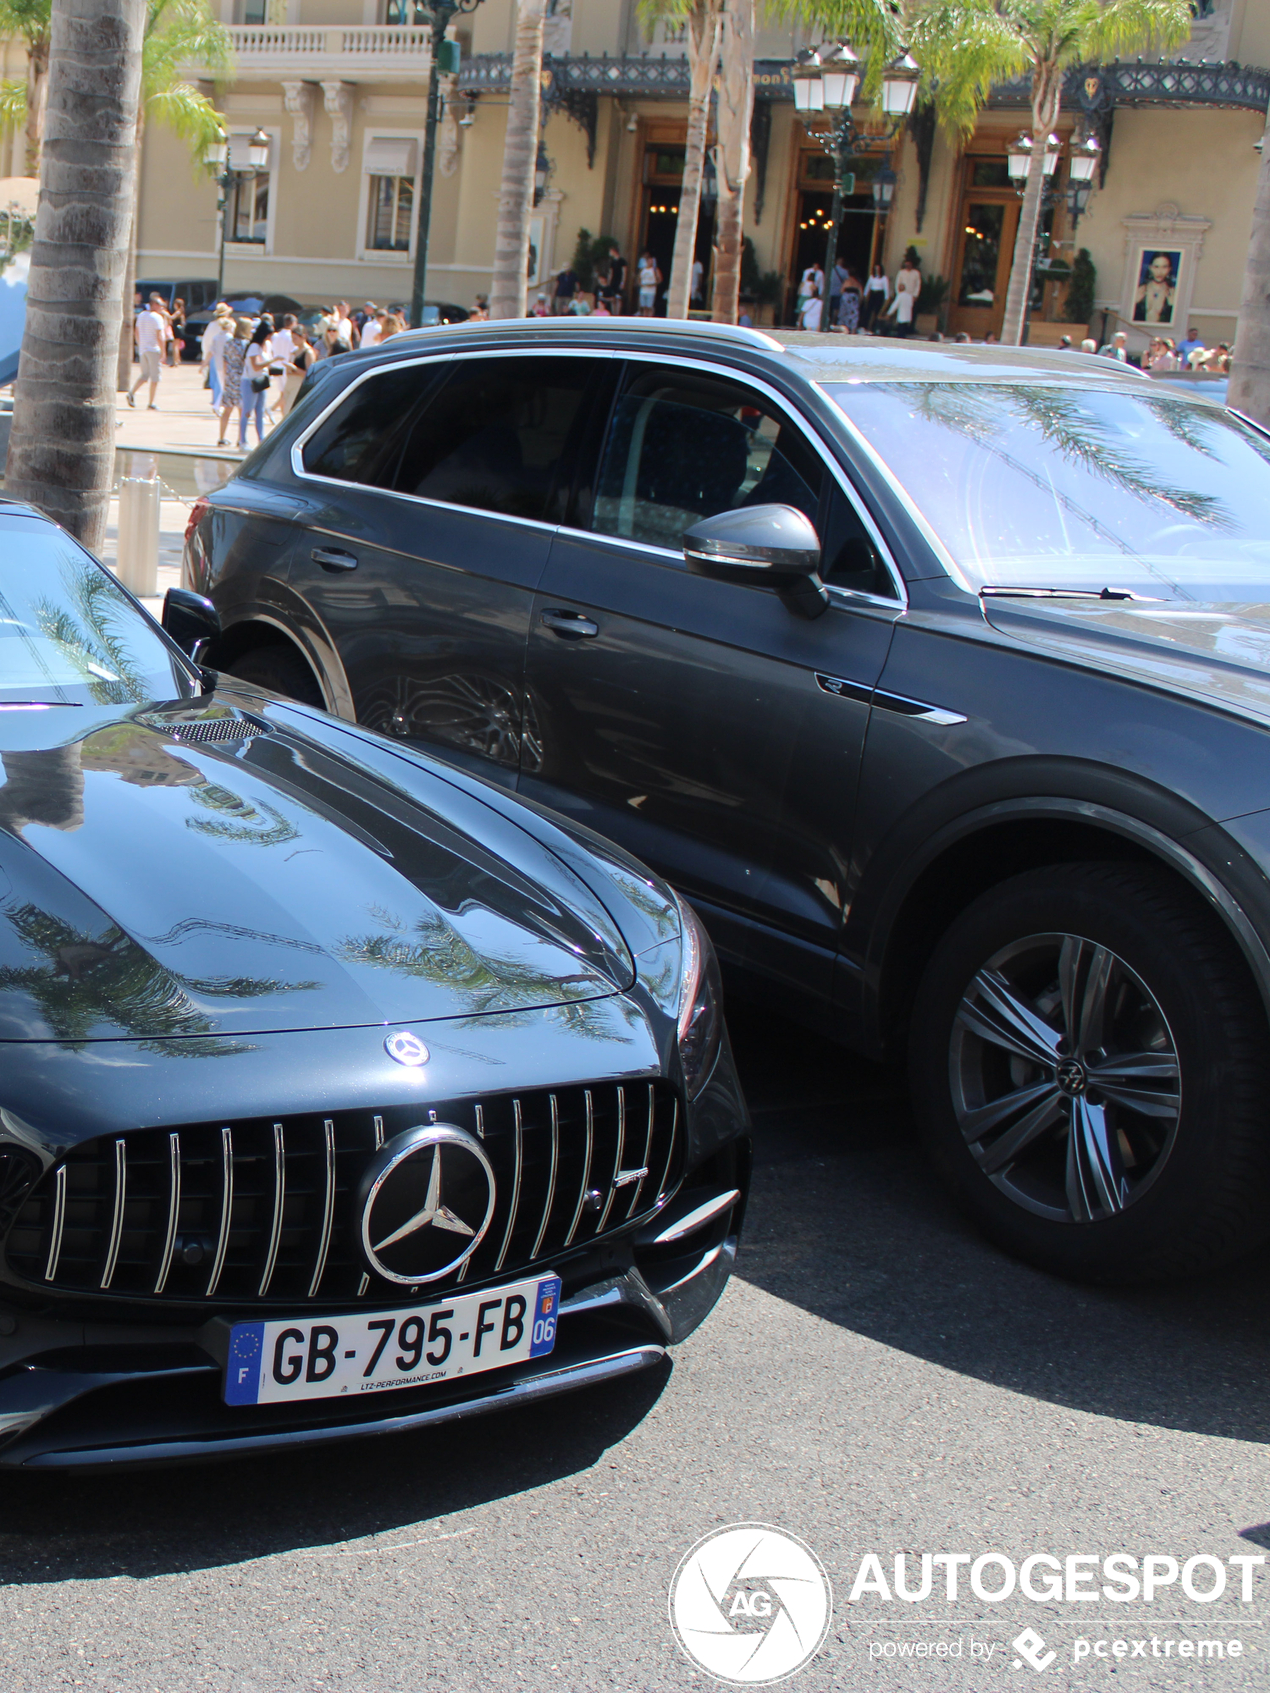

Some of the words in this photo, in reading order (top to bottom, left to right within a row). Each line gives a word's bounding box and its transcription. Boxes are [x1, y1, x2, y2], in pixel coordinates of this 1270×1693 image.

[272, 1294, 527, 1385] GB-795-FB
[533, 1317, 556, 1344] 06
[238, 1367, 250, 1384] F
[360, 1371, 447, 1391] LTZ-PERFORMANCE.COM
